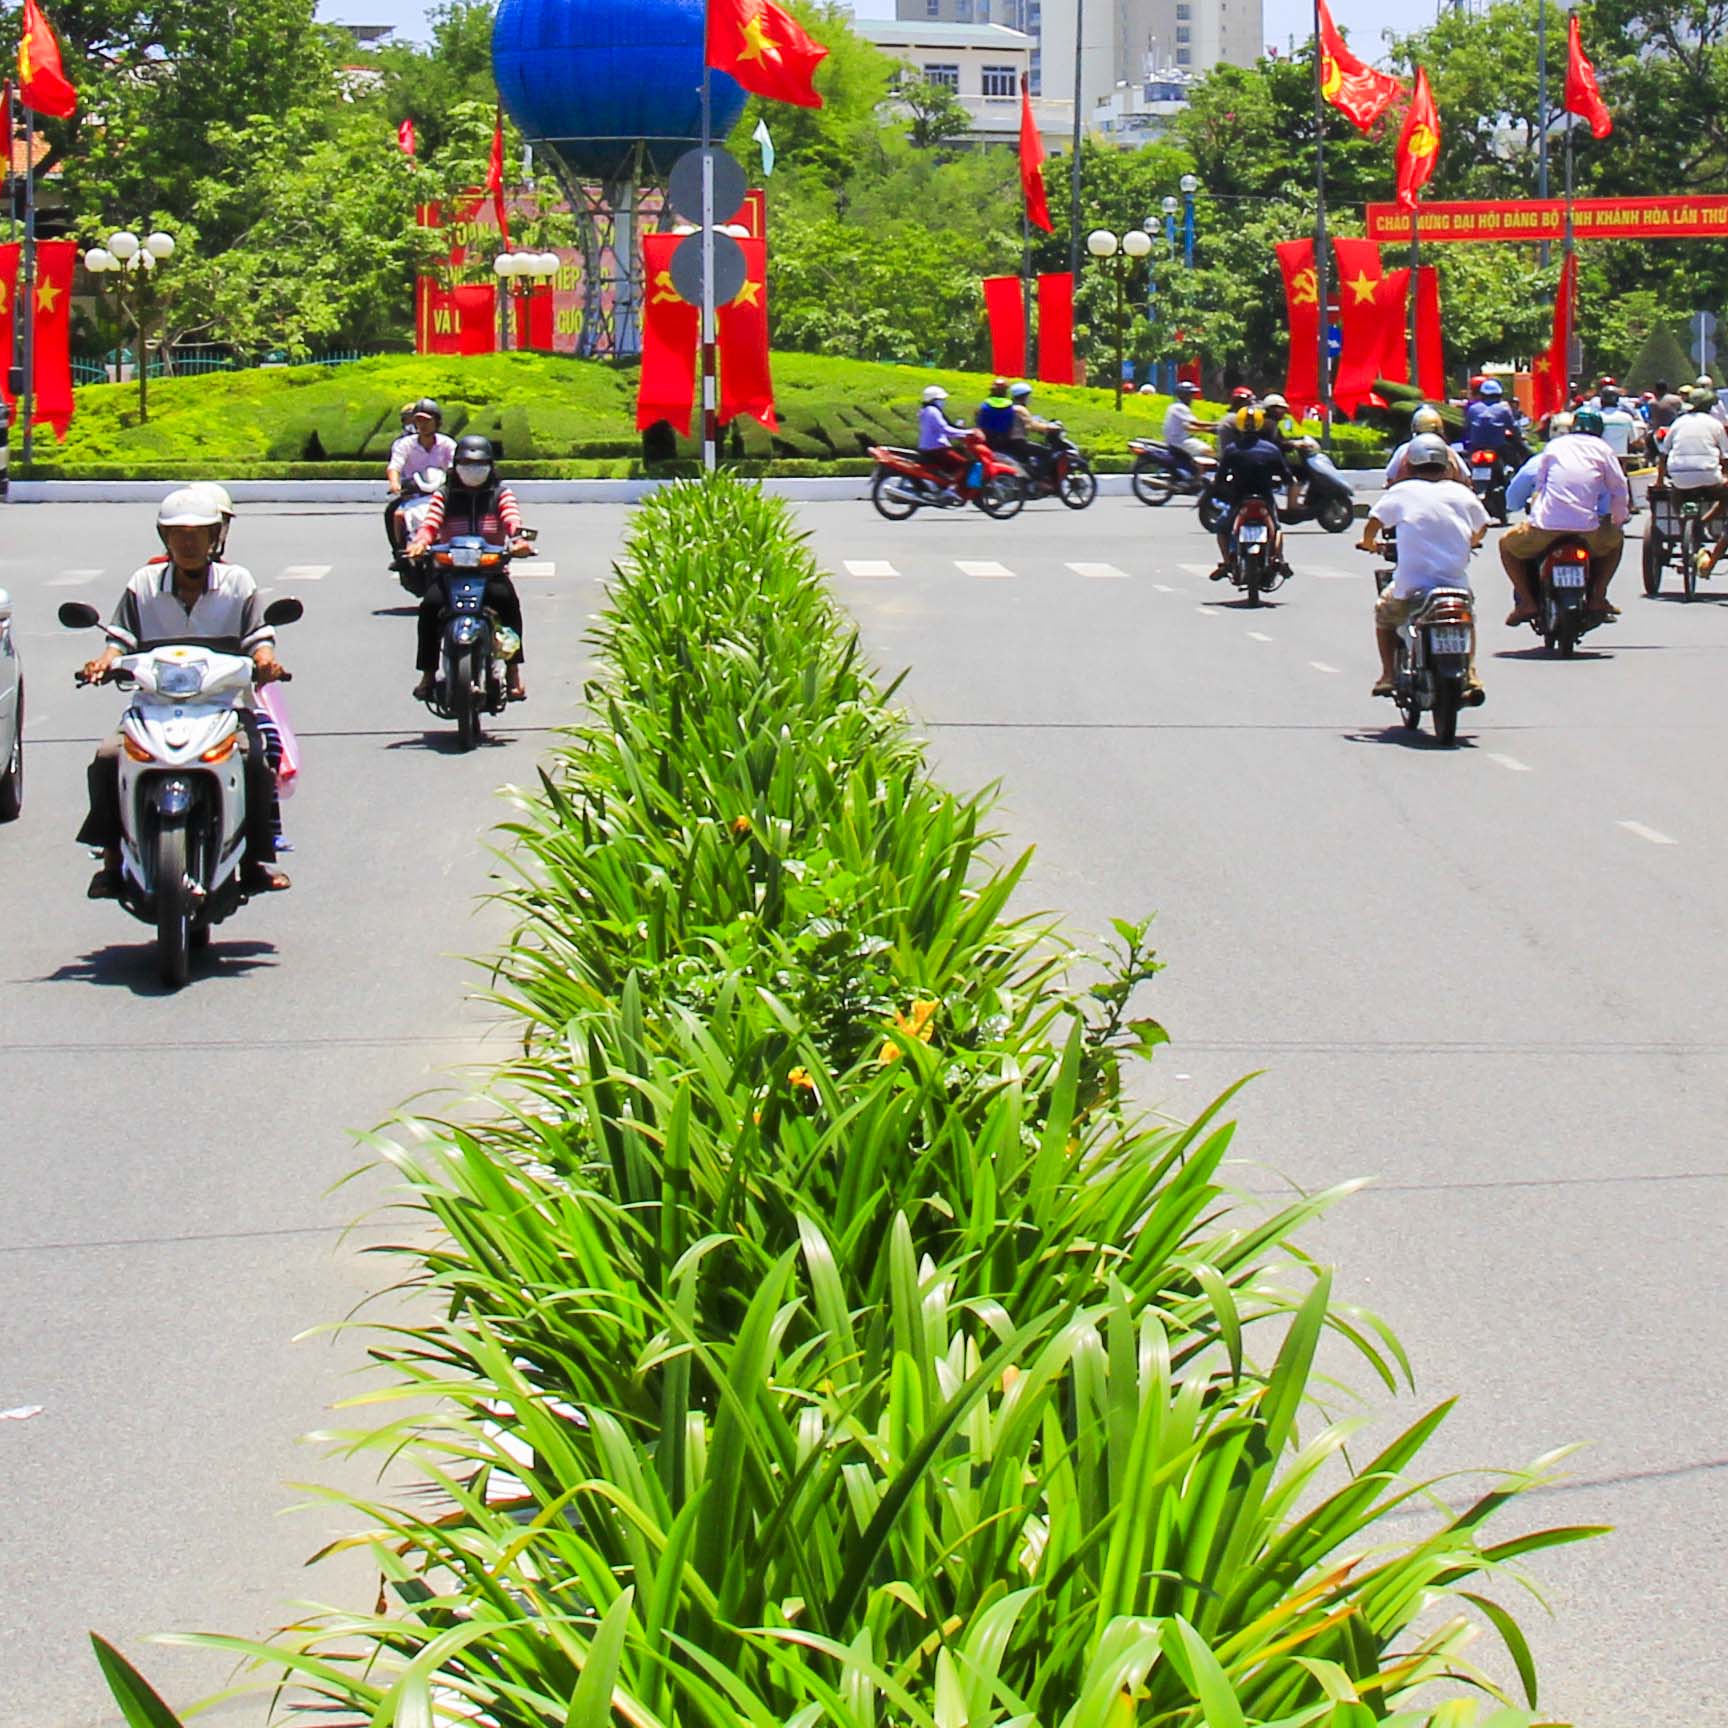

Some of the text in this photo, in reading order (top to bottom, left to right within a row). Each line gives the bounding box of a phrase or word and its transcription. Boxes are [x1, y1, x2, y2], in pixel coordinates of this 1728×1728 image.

[1376, 211, 1410, 232] CHÀO
[1453, 214, 1475, 233] ĐẠI
[1478, 210, 1500, 232] HỘI
[1504, 208, 1538, 227] ĐẢNG
[1542, 208, 1559, 229] BỘ
[1596, 207, 1639, 225] KHÁNH
[1643, 206, 1670, 225] HÒA
[1674, 204, 1697, 224] LẦN
[1701, 206, 1728, 224] THỨ
